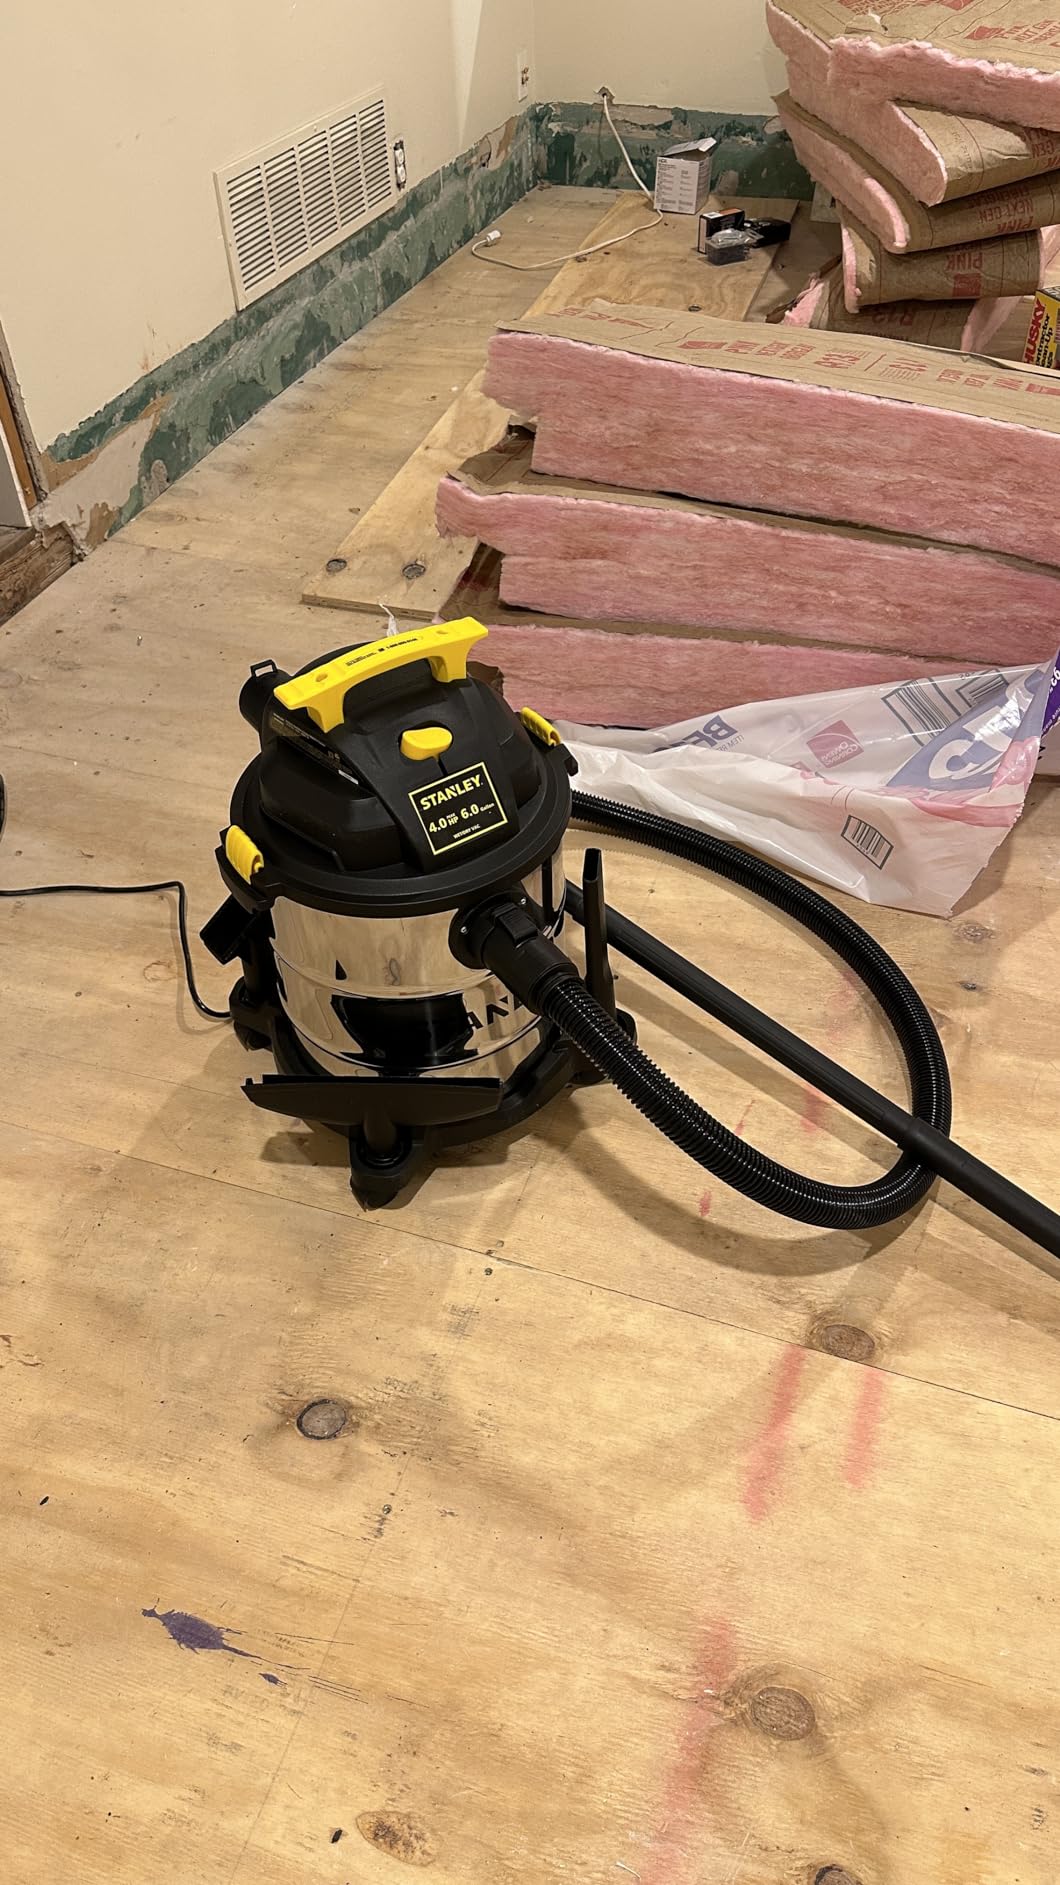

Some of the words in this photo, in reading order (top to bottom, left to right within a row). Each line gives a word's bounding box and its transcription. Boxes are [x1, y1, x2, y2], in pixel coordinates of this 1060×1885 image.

[944, 252, 983, 272] PINK
[1035, 313, 1050, 367] ontractor
[420, 774, 480, 811] STANLEY
[428, 817, 448, 833] 4.0
[447, 815, 459, 826] HP
[460, 803, 480, 820] 6.0
